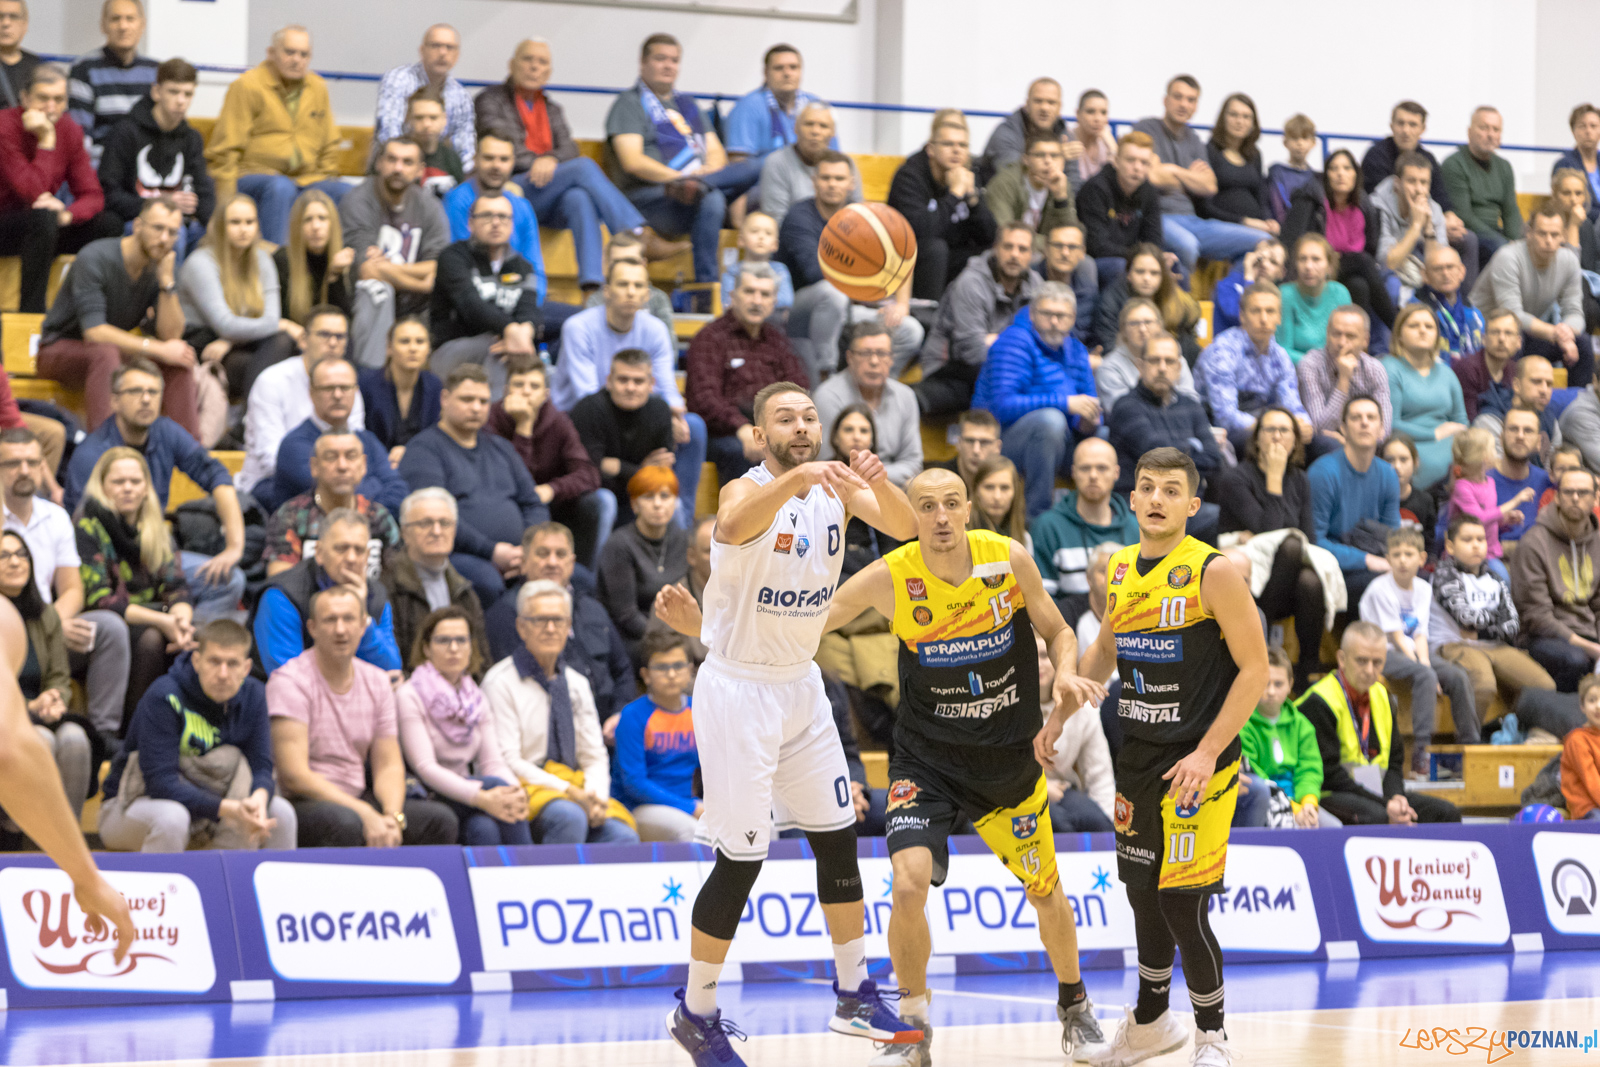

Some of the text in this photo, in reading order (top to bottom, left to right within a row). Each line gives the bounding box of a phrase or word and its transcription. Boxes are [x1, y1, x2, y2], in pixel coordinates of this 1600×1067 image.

[827, 524, 840, 556] 0
[756, 605, 781, 617] Dbamy
[788, 609, 815, 617] zdrowie
[988, 589, 1013, 627] 15
[1158, 596, 1187, 628] 10
[930, 686, 969, 696] CAPITAL
[834, 775, 849, 808] 0
[1020, 846, 1041, 876] 15
[1168, 831, 1196, 864] 10
[1411, 879, 1483, 905] Danuty
[276, 911, 432, 943] BIOFARM
